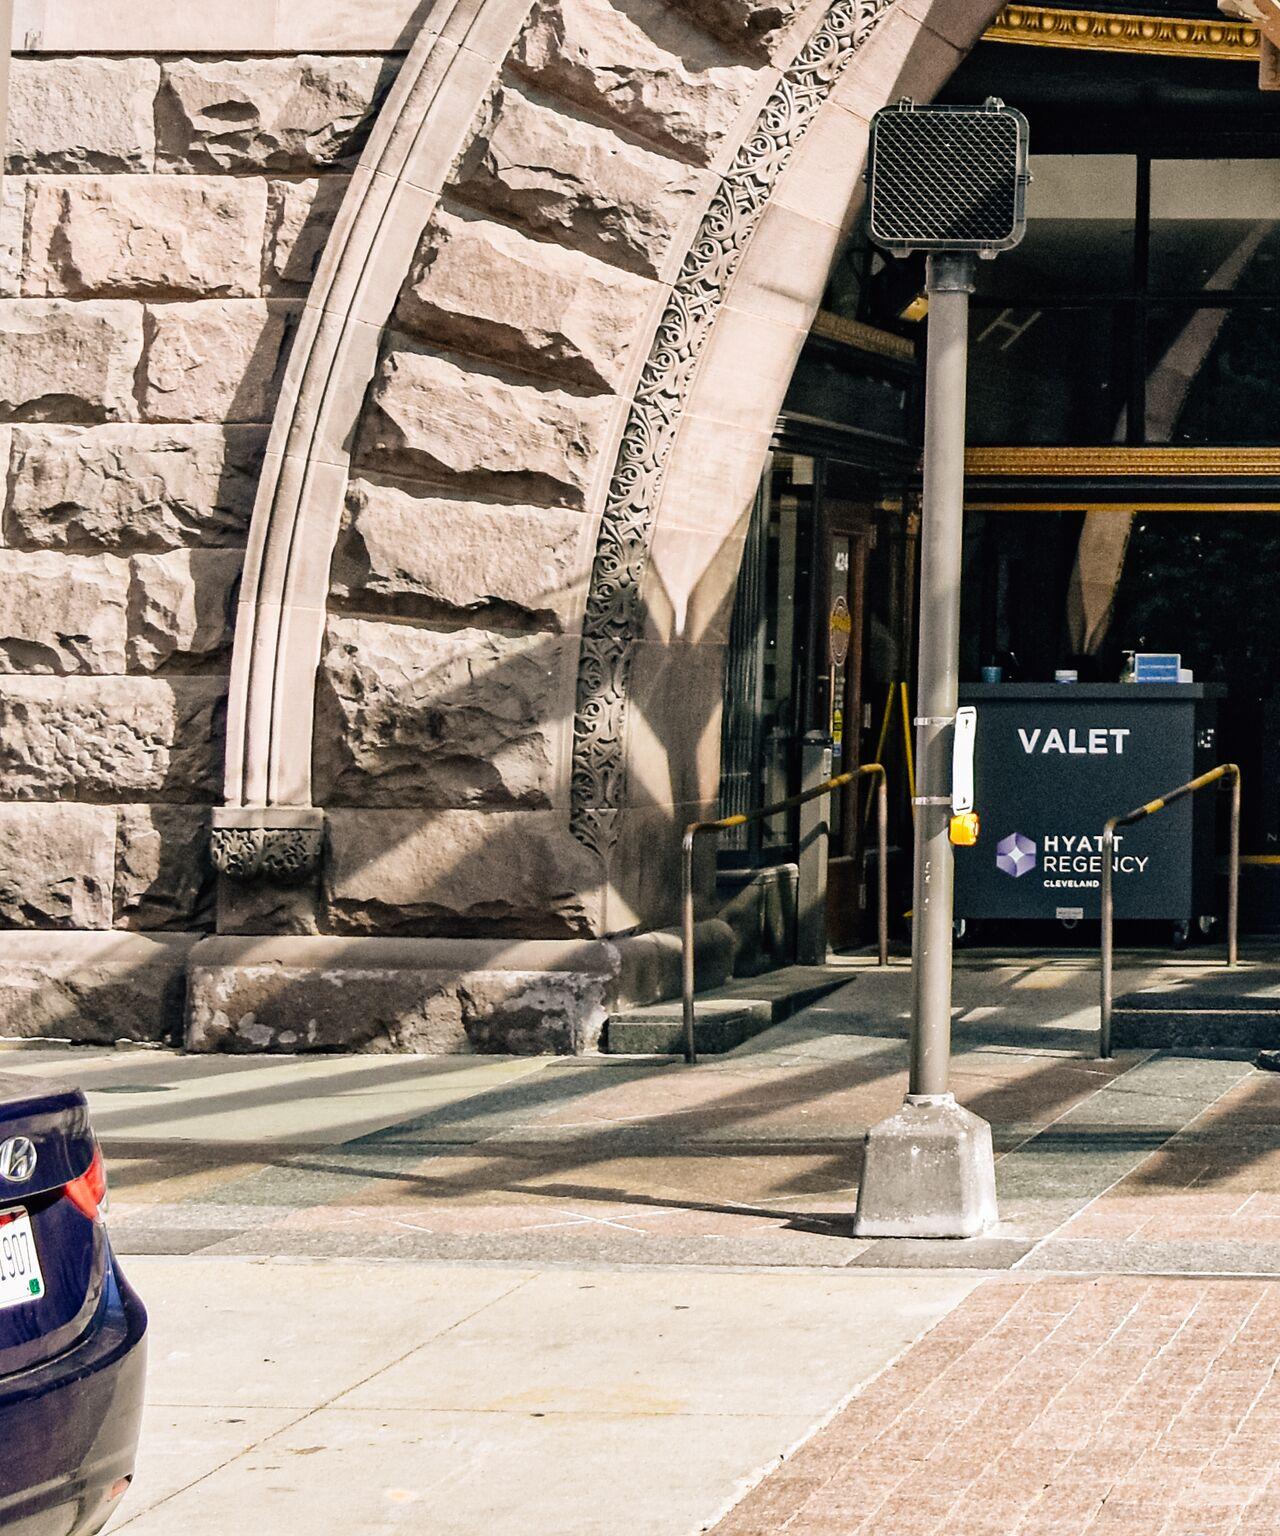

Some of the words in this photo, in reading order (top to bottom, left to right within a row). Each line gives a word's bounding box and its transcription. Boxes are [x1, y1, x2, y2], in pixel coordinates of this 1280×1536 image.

[1018, 728, 1130, 754] VALET
[1044, 836, 1123, 852] HYATT
[1043, 880, 1099, 888] CLEVELAND
[0, 1232, 31, 1280] 907
